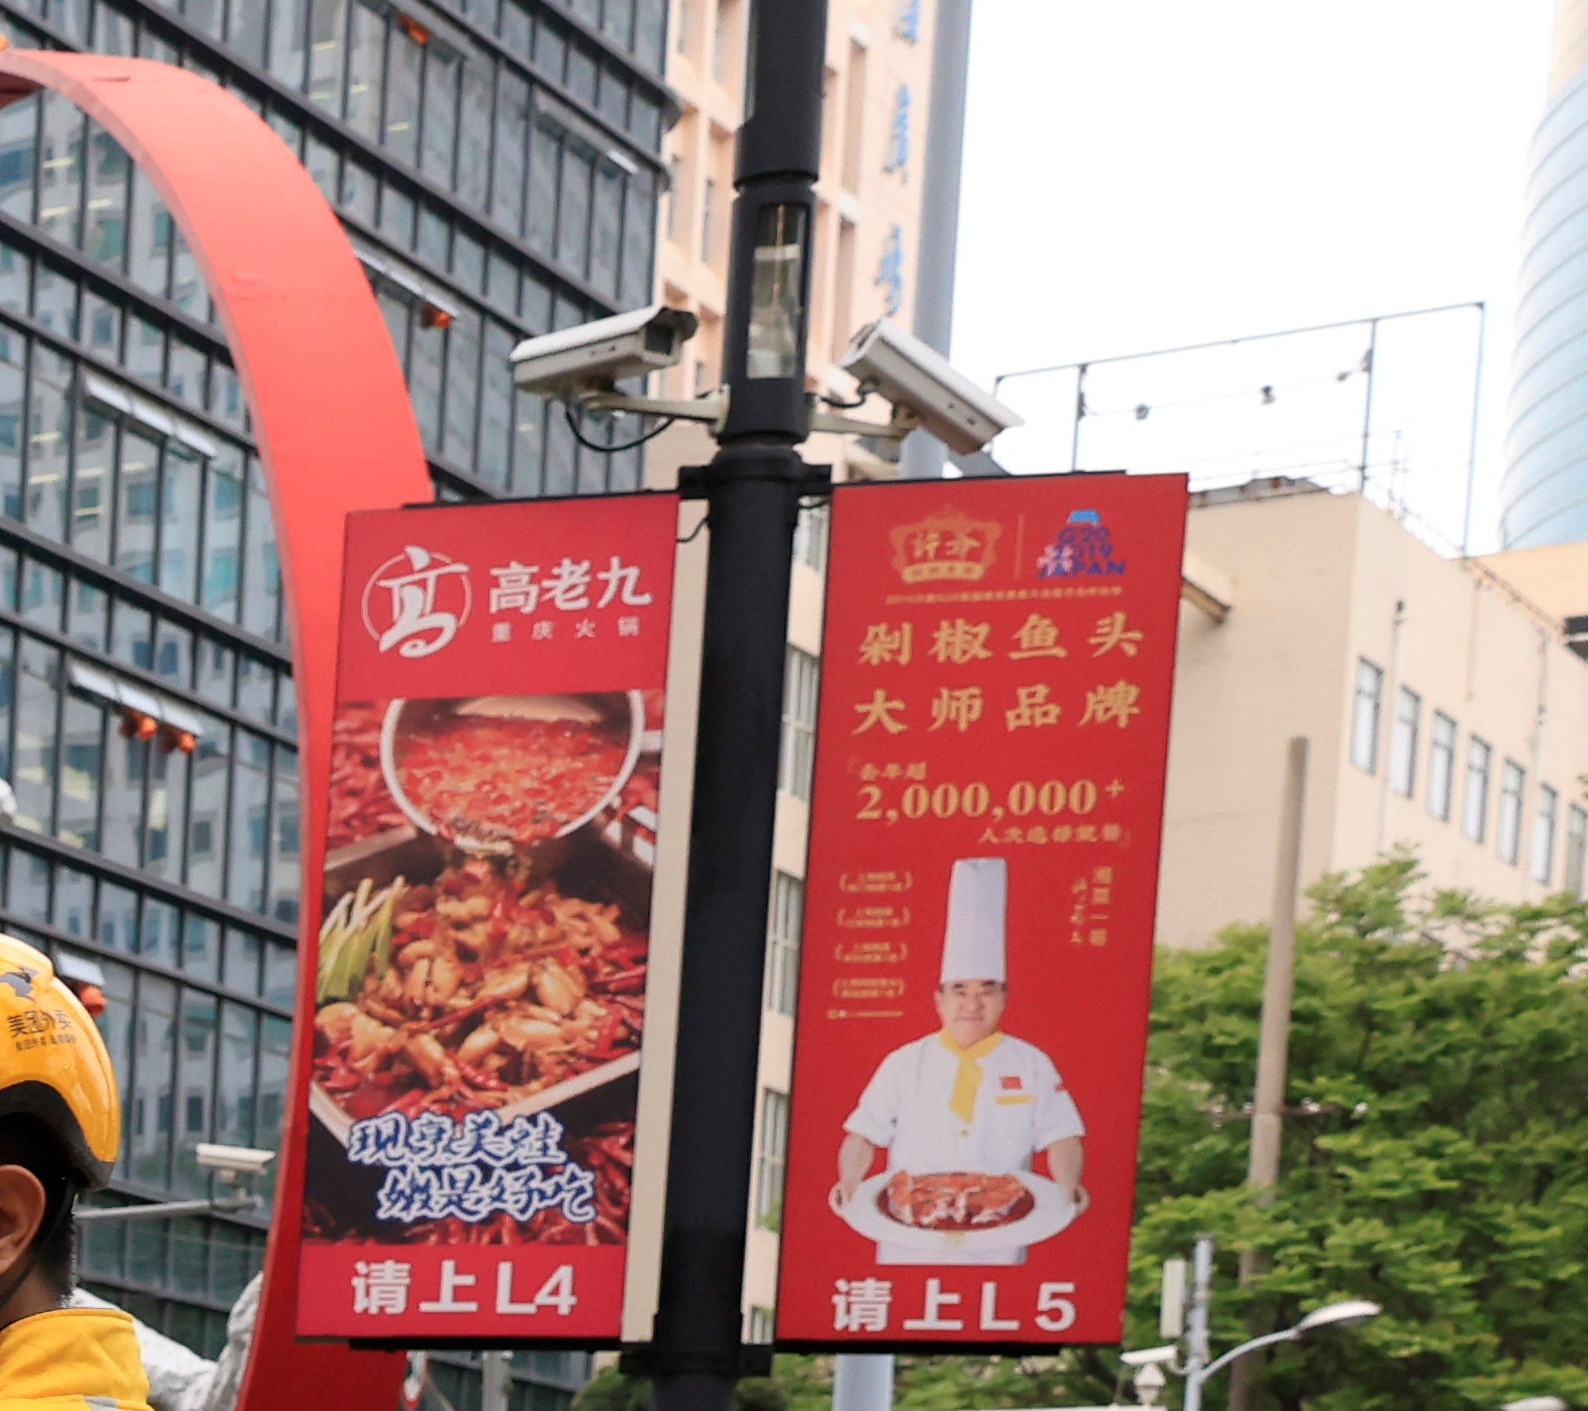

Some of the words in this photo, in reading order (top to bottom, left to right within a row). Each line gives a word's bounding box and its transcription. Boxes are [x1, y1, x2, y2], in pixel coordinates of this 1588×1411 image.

[489, 555, 653, 614] 高老九
[491, 616, 640, 643] 重庆火锅
[858, 610, 1144, 666] 剁椒鱼头
[851, 680, 1141, 735] 大师品牌
[855, 778, 1124, 825] 2,000,000+
[7, 1009, 73, 1039] 美团外卖
[351, 1260, 578, 1315] 请上L4
[830, 1278, 1078, 1334] 请上L5
